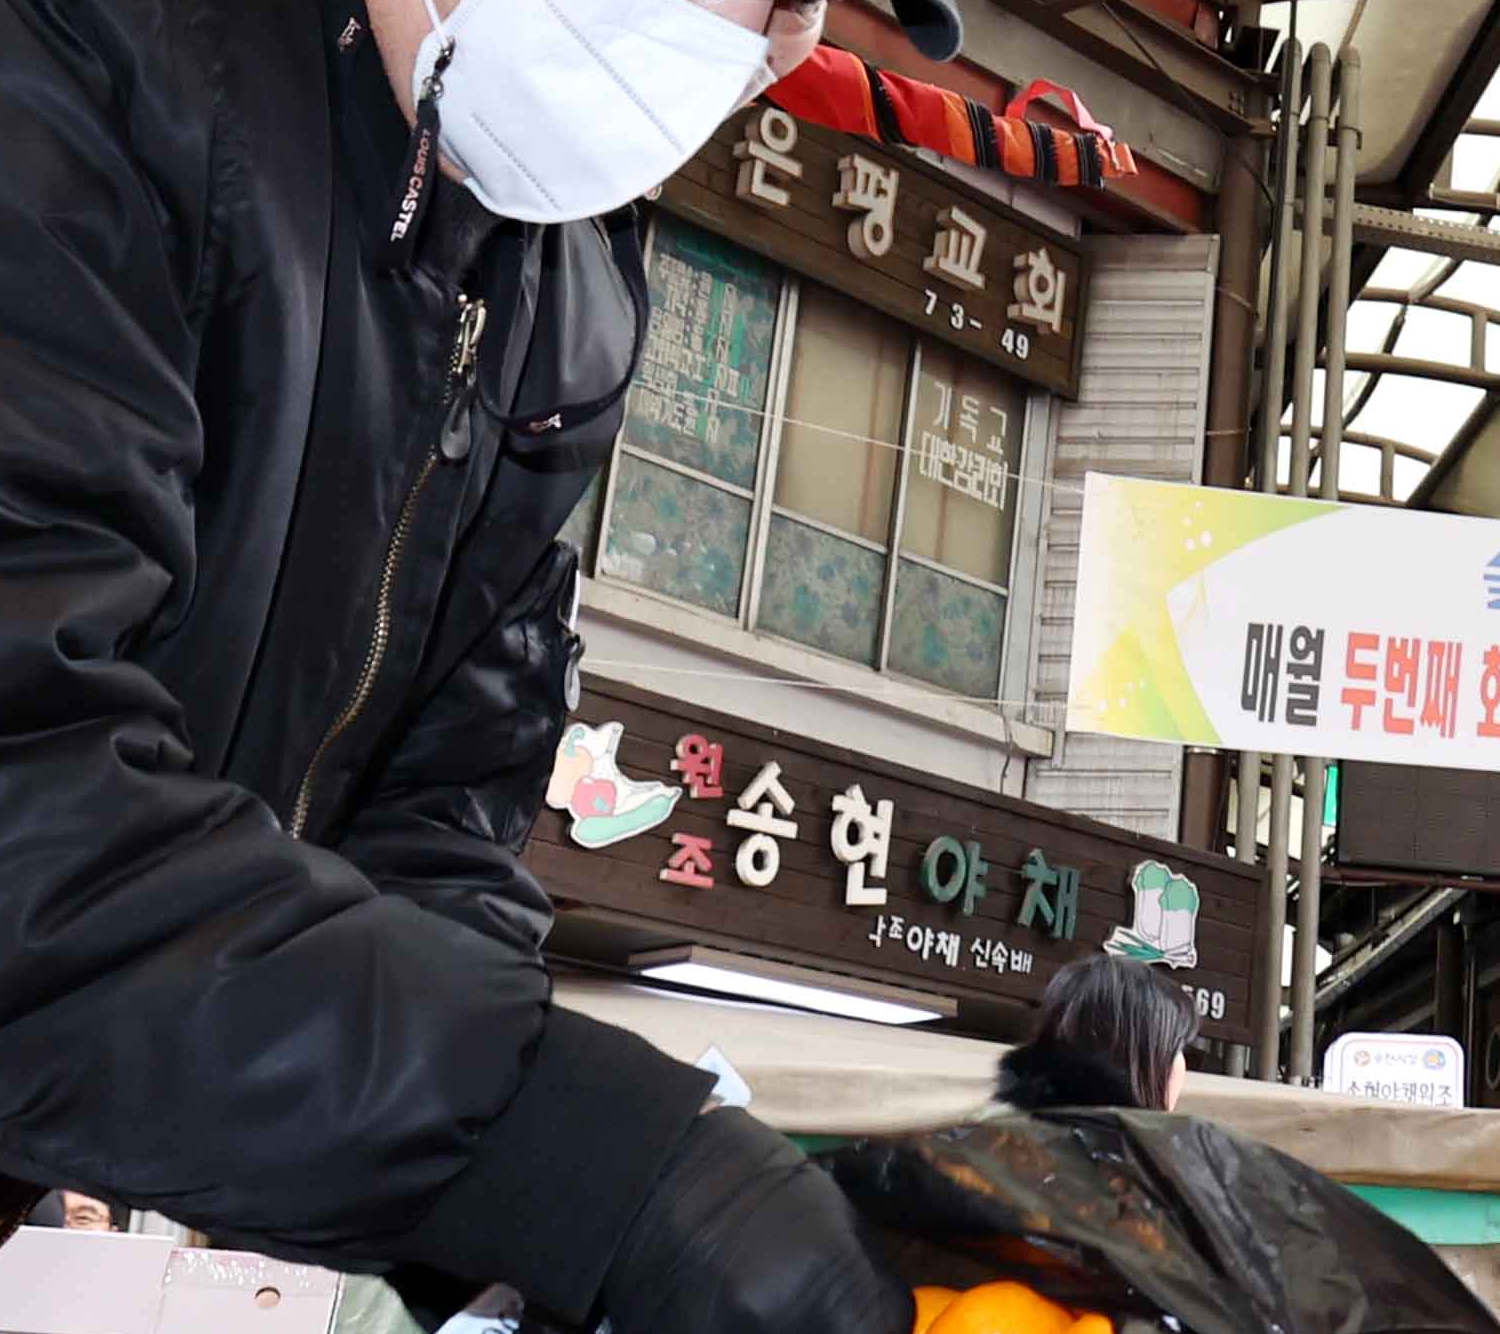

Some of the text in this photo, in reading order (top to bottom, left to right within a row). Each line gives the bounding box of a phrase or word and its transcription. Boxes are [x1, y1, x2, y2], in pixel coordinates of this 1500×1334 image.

[734, 109, 1066, 335] 은평교회
[919, 434, 1006, 512] 대한감리회
[932, 382, 1008, 455] 기독교
[1241, 623, 1325, 727] 매월
[1340, 631, 1463, 739] 두번째
[660, 732, 723, 891] 원조
